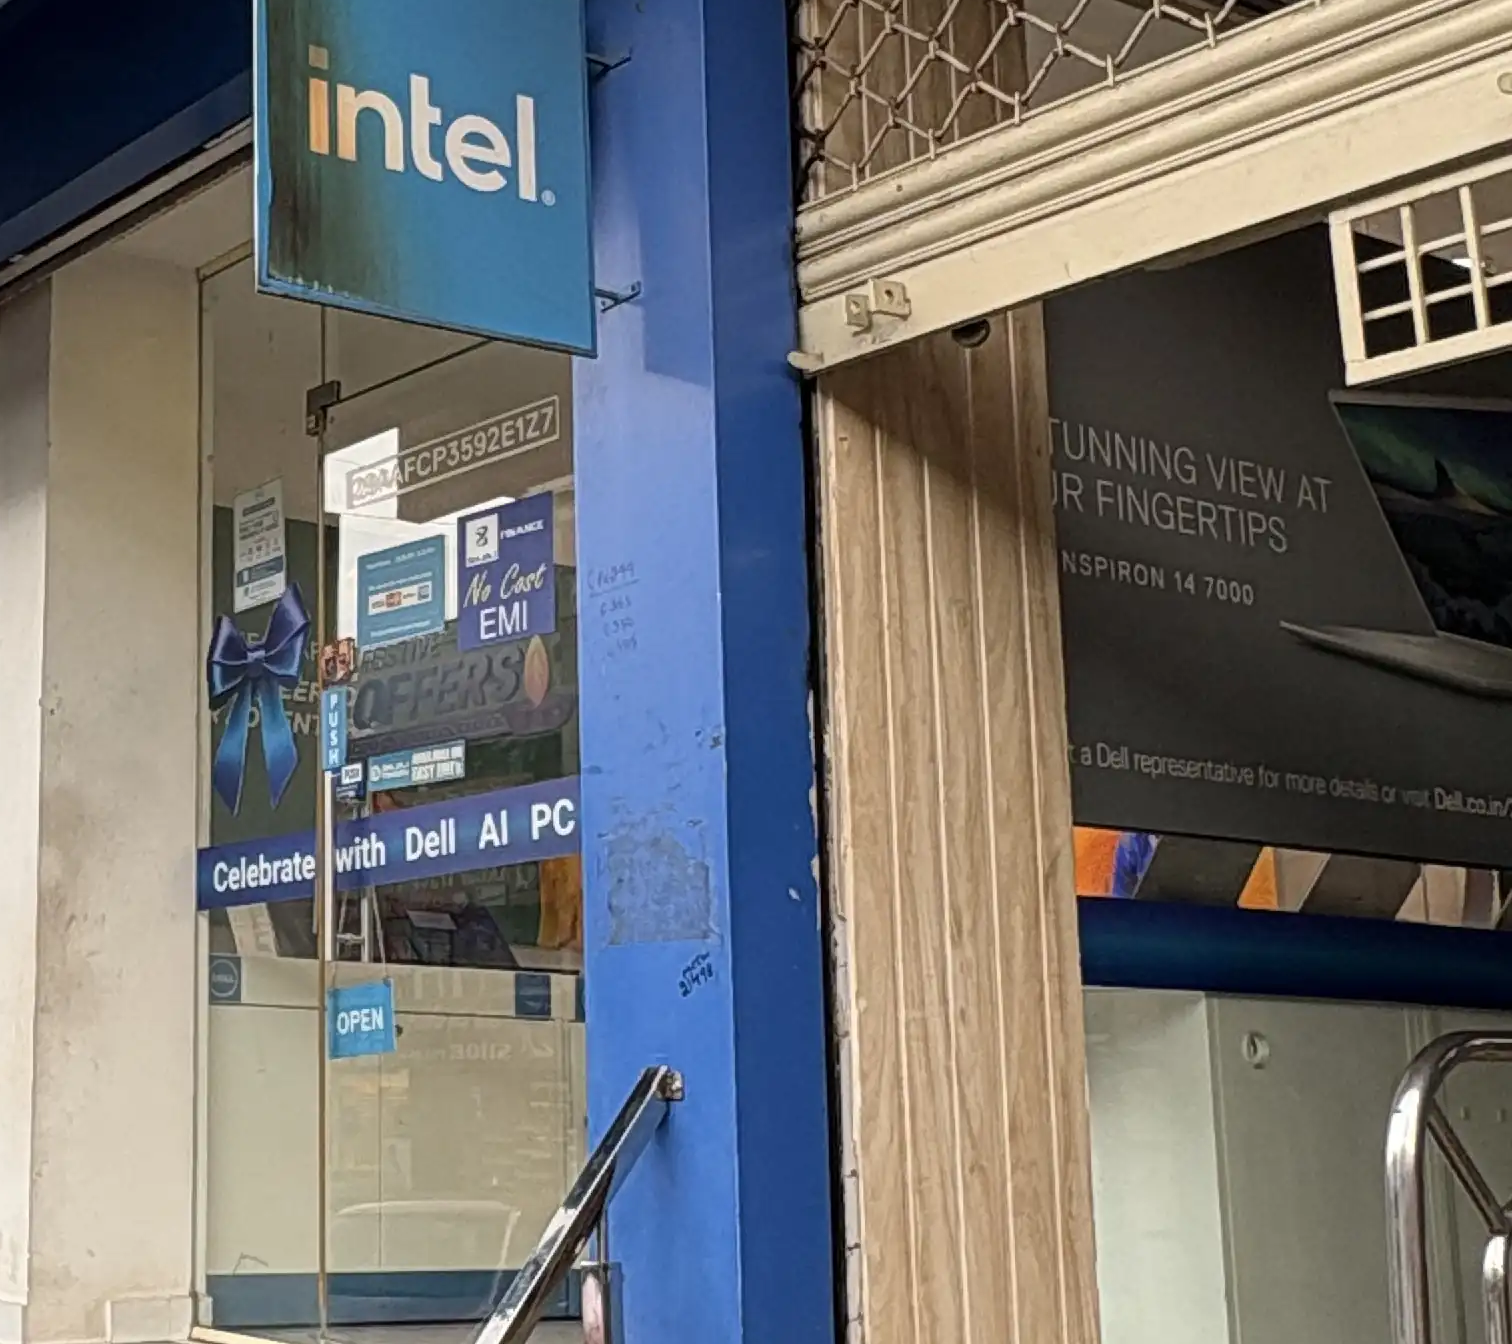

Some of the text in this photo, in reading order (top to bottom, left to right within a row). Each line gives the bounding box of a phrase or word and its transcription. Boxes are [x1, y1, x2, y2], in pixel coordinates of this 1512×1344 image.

[1048, 417, 1332, 513] TUNNING VIEW AT
[1097, 479, 1288, 553] FINGERTIPS
[463, 563, 547, 608] No Cost
[1061, 549, 1254, 605] NSPIRON 14 7000
[480, 600, 527, 639] EMI
[328, 694, 340, 765] PUSH
[1081, 746, 1092, 766] a
[1096, 742, 1129, 770] Dell
[1134, 752, 1254, 787] representative
[1258, 767, 1281, 789] for
[1286, 772, 1327, 795] more
[1329, 776, 1379, 802] details
[1381, 785, 1396, 804] or
[1434, 787, 1512, 819] Dell.co.in/
[213, 852, 316, 893] Celebrate
[335, 833, 387, 873] with
[406, 818, 456, 862] Dell
[531, 798, 576, 840] PC
[337, 1006, 384, 1036] OPEN
